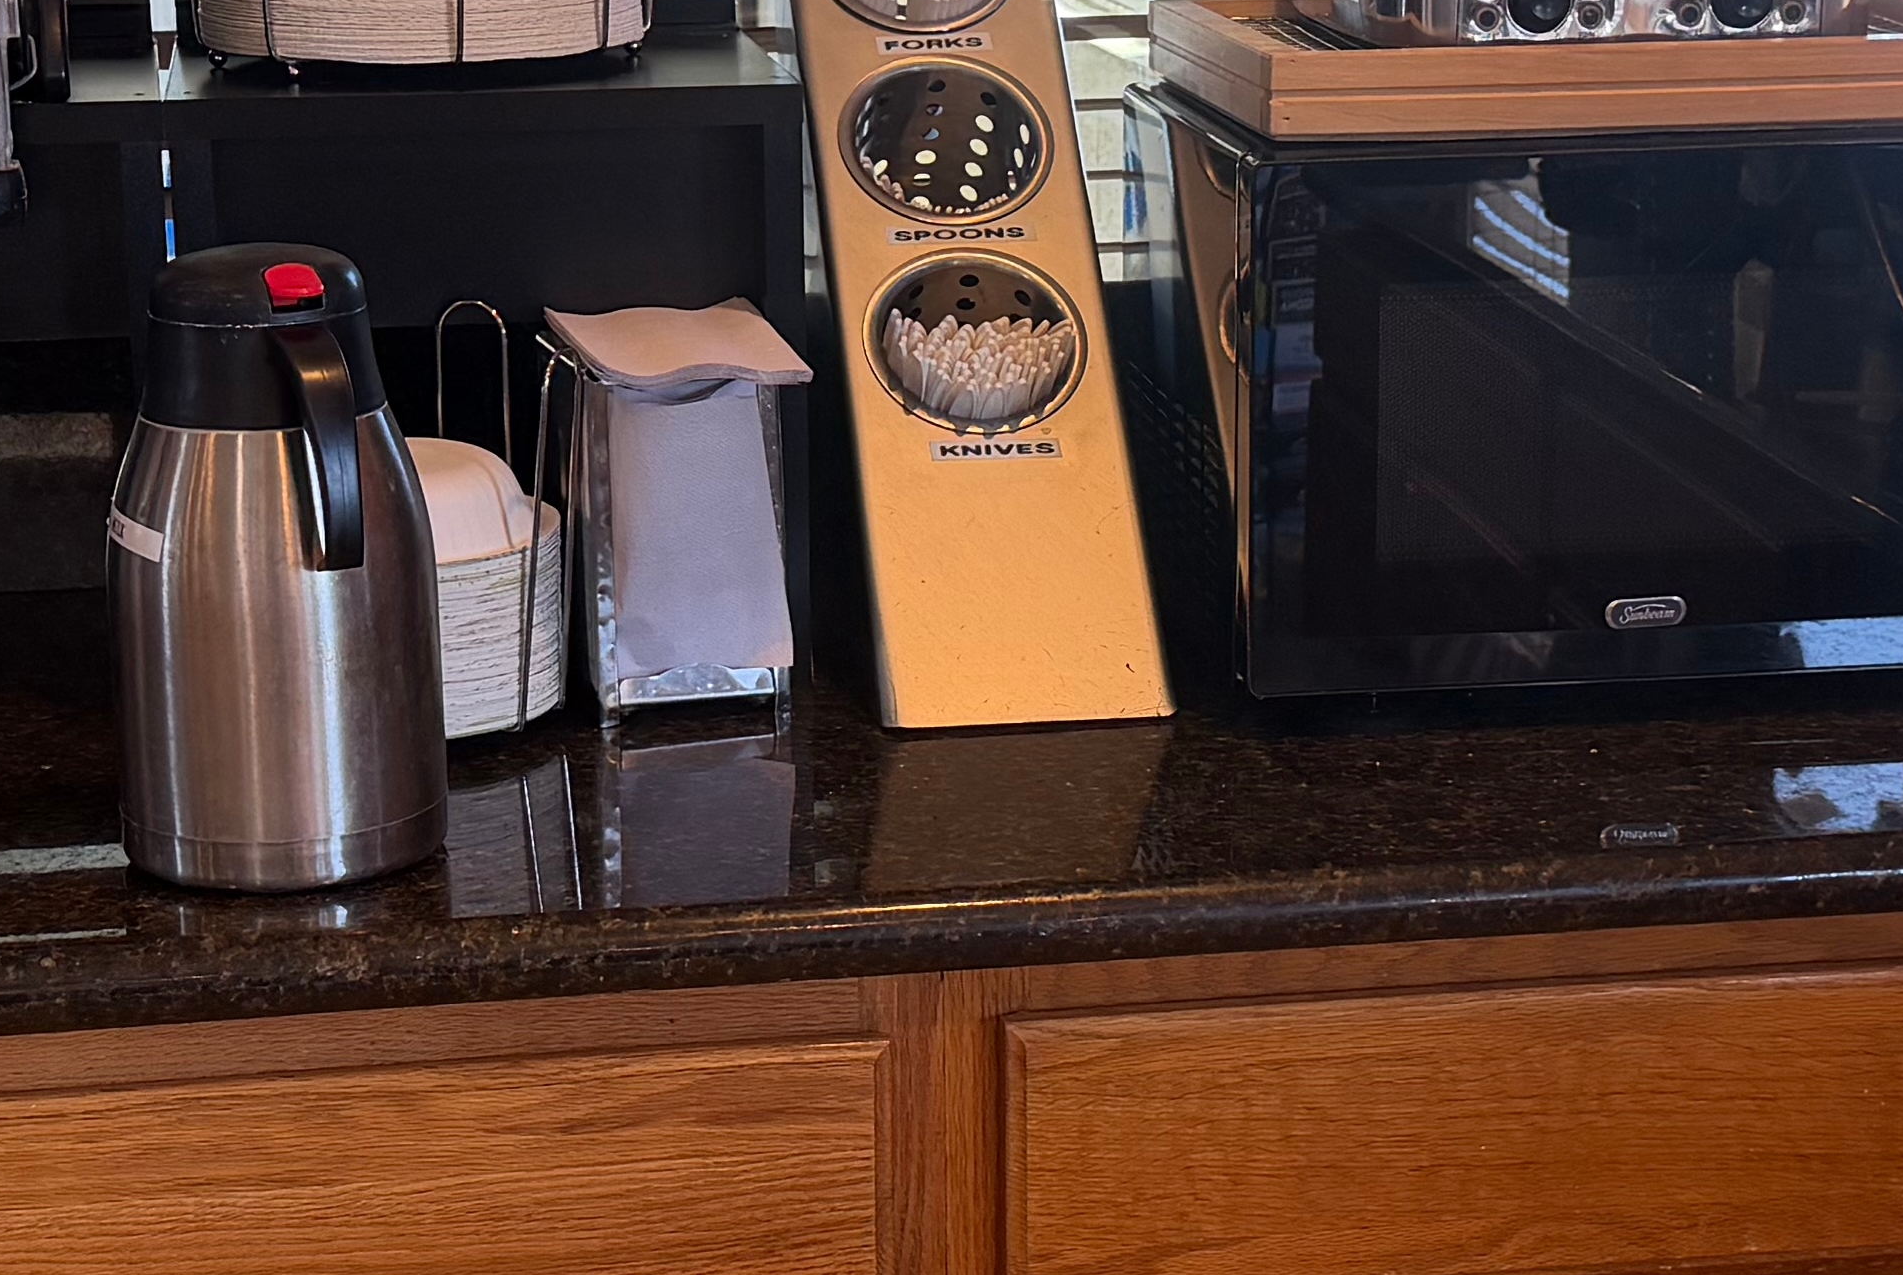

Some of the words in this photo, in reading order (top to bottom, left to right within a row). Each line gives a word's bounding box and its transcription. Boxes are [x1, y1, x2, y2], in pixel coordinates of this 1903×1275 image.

[885, 36, 983, 51] FORKS
[894, 227, 1025, 242] SPOONS
[940, 442, 1055, 456] KNIVES
[1619, 604, 1675, 624] Sunbeam
